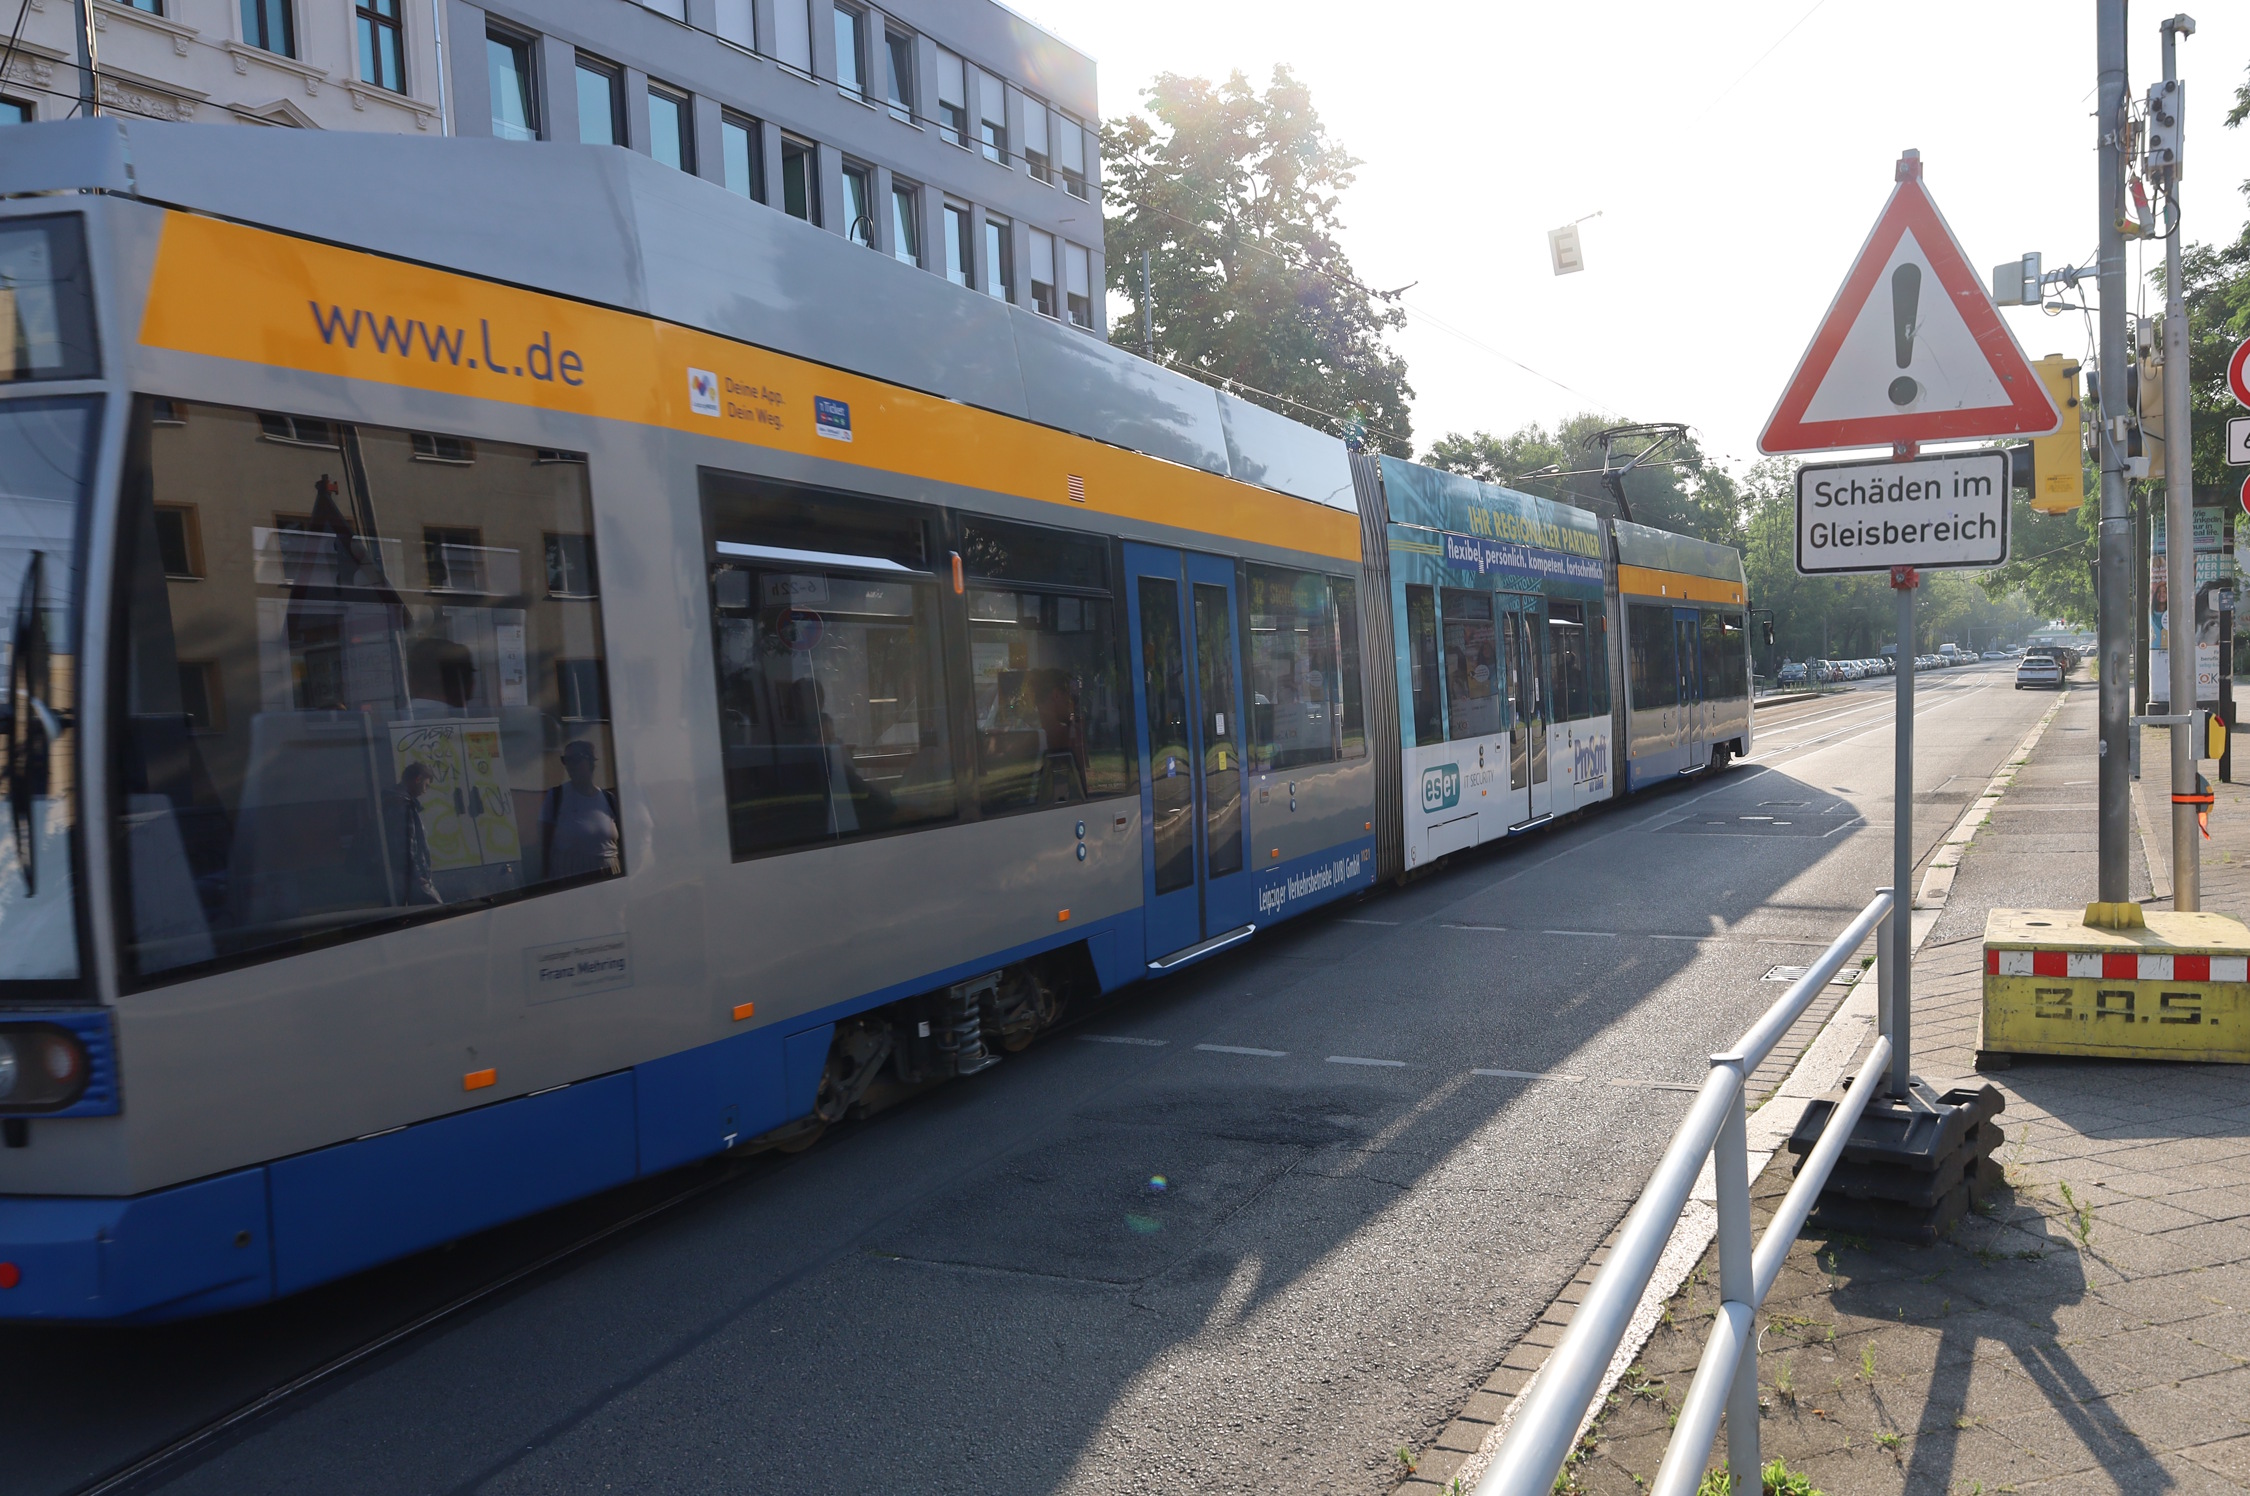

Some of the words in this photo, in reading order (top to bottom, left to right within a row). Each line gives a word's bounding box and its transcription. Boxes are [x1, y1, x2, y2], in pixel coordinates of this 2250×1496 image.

[1554, 233, 1577, 269] E
[309, 300, 585, 387] www.L.de
[725, 376, 758, 398] Deine
[761, 386, 785, 407] App.
[727, 402, 755, 421] Dein
[756, 408, 784, 430] Weg.
[1814, 476, 1942, 508] Schäden
[1953, 471, 1992, 498] im
[1467, 505, 1492, 536] IHR
[1493, 511, 1562, 550] REGIONALER
[1561, 527, 1601, 557] PARTNER
[1810, 512, 1996, 549] Gleisbereich
[1447, 536, 1483, 562] flexibel.
[1486, 545, 1527, 569] persönlich.
[1528, 555, 1566, 577] kompetent.
[1574, 734, 1608, 782] ProSoft
[1463, 776, 1469, 789] IT
[1470, 769, 1495, 787] SECURITY
[1259, 882, 1286, 915] Leipziger
[1287, 864, 1332, 901] Verkehrsbetriebe
[1333, 858, 1346, 888] (LVB)
[1346, 853, 1361, 879] GmbH
